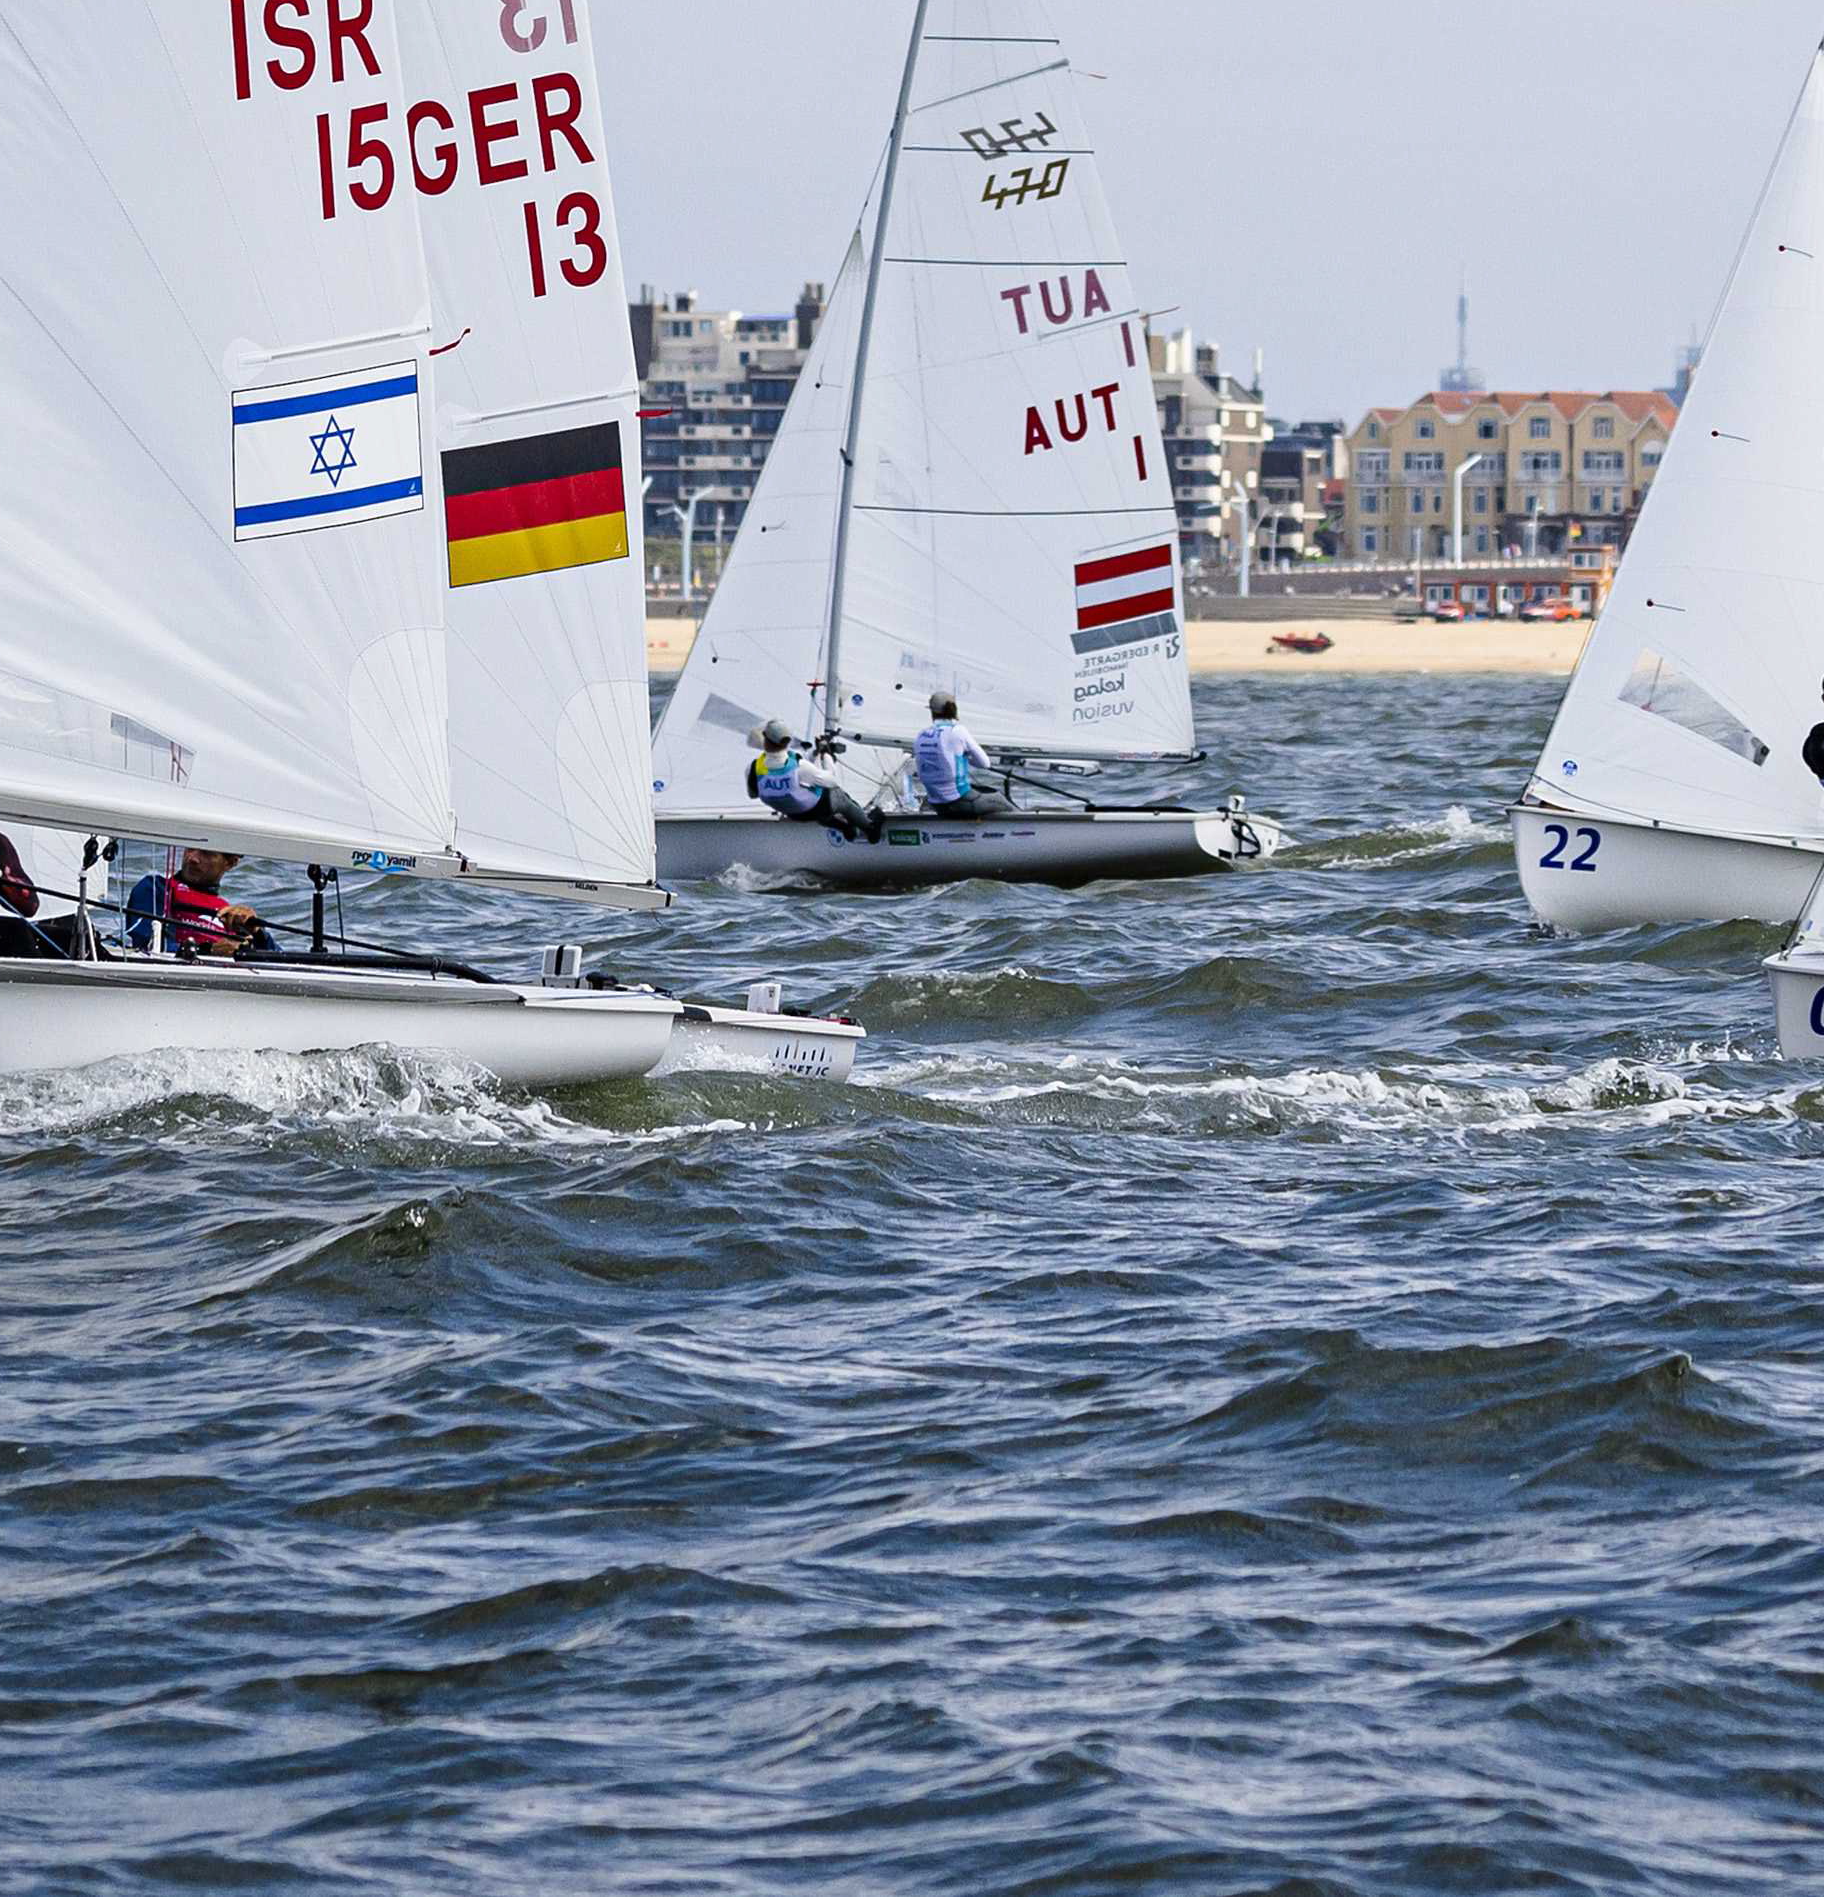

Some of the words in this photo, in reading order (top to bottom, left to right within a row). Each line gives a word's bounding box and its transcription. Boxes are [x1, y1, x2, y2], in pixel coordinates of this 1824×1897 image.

[316, 102, 395, 221] 15
[407, 72, 596, 197] GER
[981, 157, 1069, 210] 470
[523, 191, 608, 299] 13
[1023, 383, 1119, 456] AUT
[763, 776, 791, 791] AUT
[387, 855, 416, 868] yamit
[1539, 823, 1602, 872] 22
